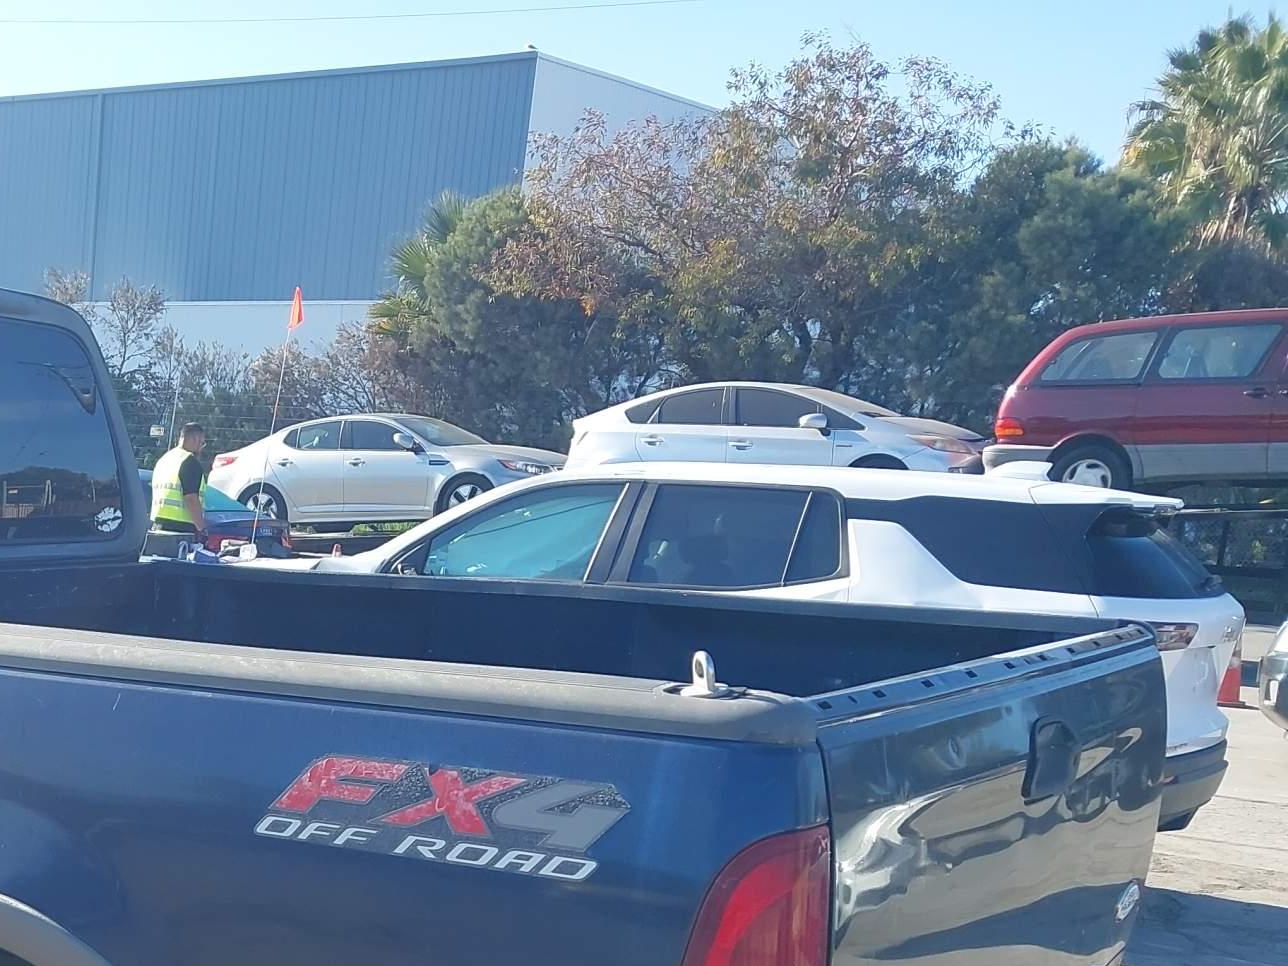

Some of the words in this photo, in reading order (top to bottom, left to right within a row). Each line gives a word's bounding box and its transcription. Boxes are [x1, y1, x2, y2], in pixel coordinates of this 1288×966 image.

[268, 755, 631, 853] FX4
[255, 815, 381, 846] OFF
[392, 835, 600, 881] ROAD
